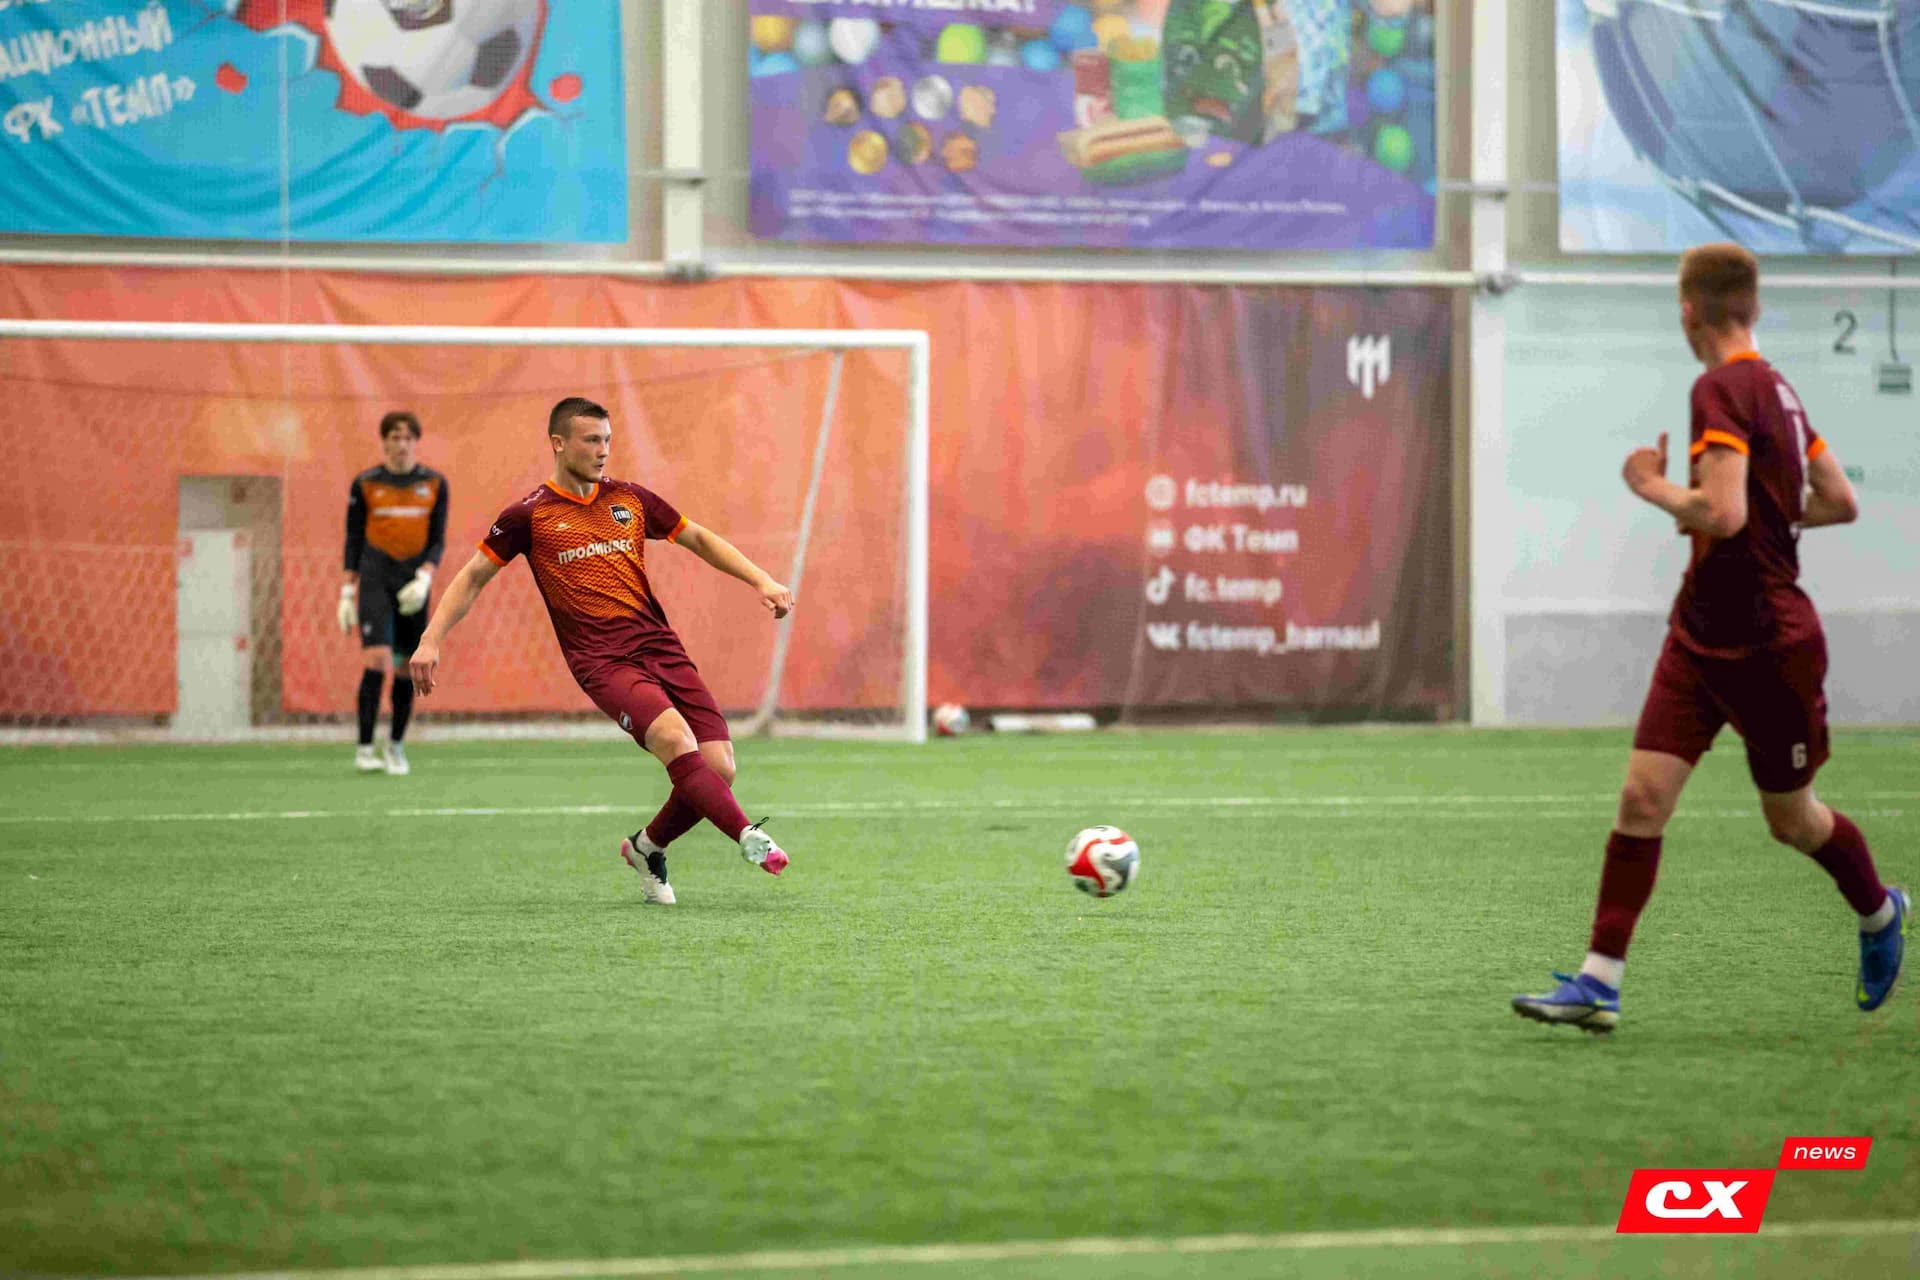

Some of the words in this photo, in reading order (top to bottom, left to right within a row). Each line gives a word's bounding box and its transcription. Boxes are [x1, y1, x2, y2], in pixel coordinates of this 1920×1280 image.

[4, 96, 63, 143] ФК
[1833, 310, 1856, 354] 2
[1185, 478, 1308, 513] fctemp.ru
[1185, 525, 1226, 553] ФК
[1791, 742, 1808, 769] 6
